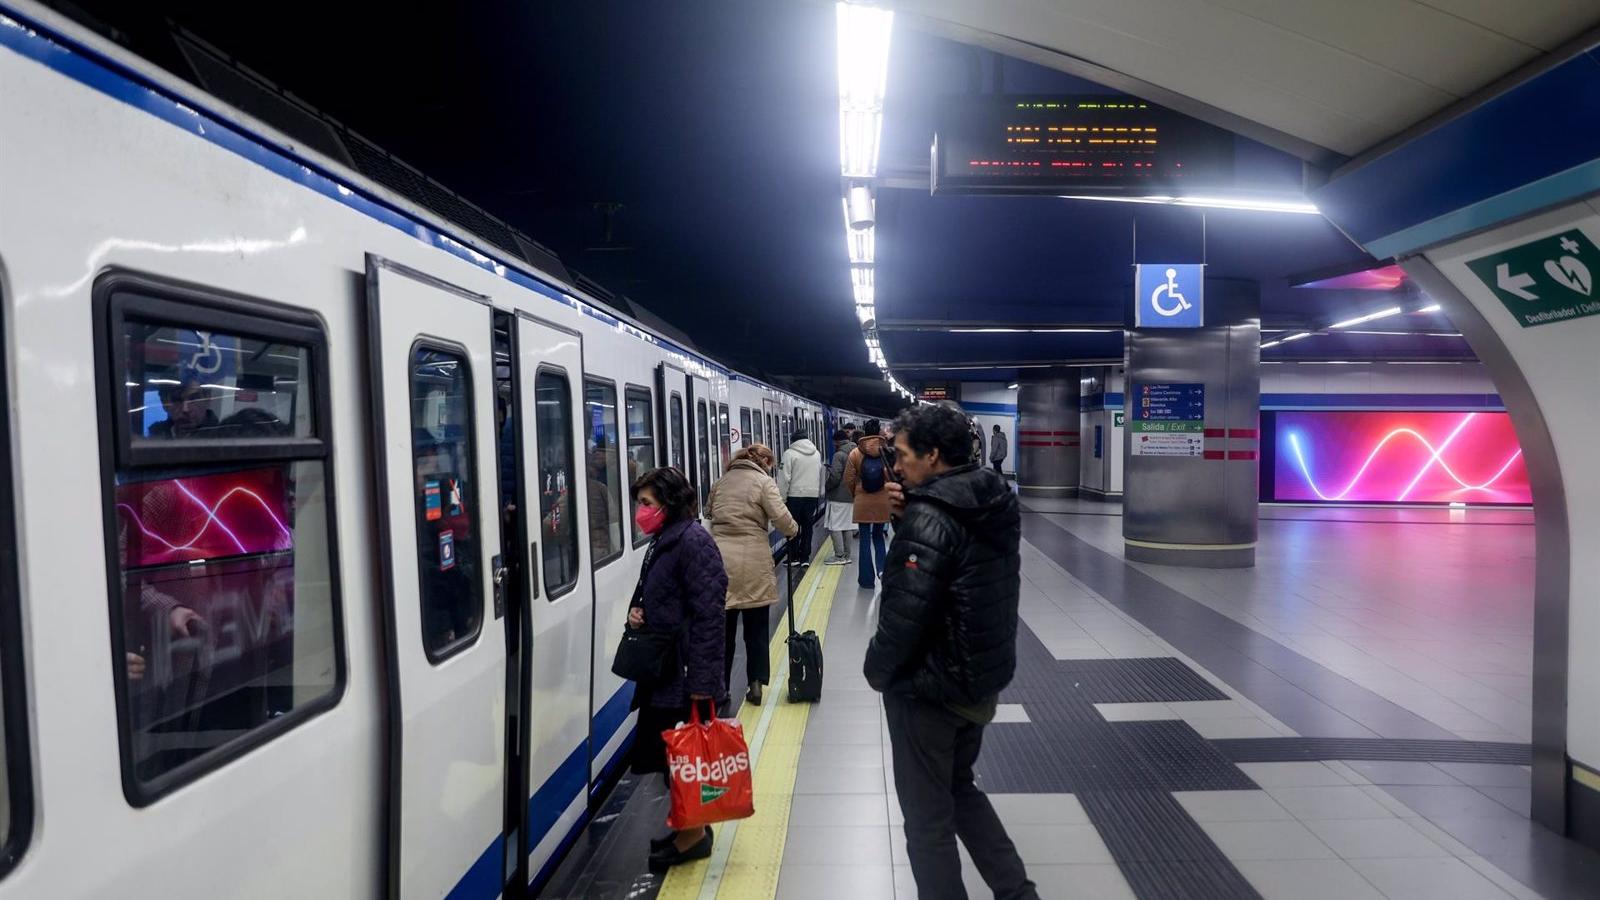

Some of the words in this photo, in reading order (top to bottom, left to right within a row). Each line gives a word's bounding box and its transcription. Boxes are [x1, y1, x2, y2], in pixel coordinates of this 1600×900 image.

[1142, 423, 1165, 431] Salida
[1171, 423, 1186, 431] Exit
[669, 752, 748, 783] rebajas
